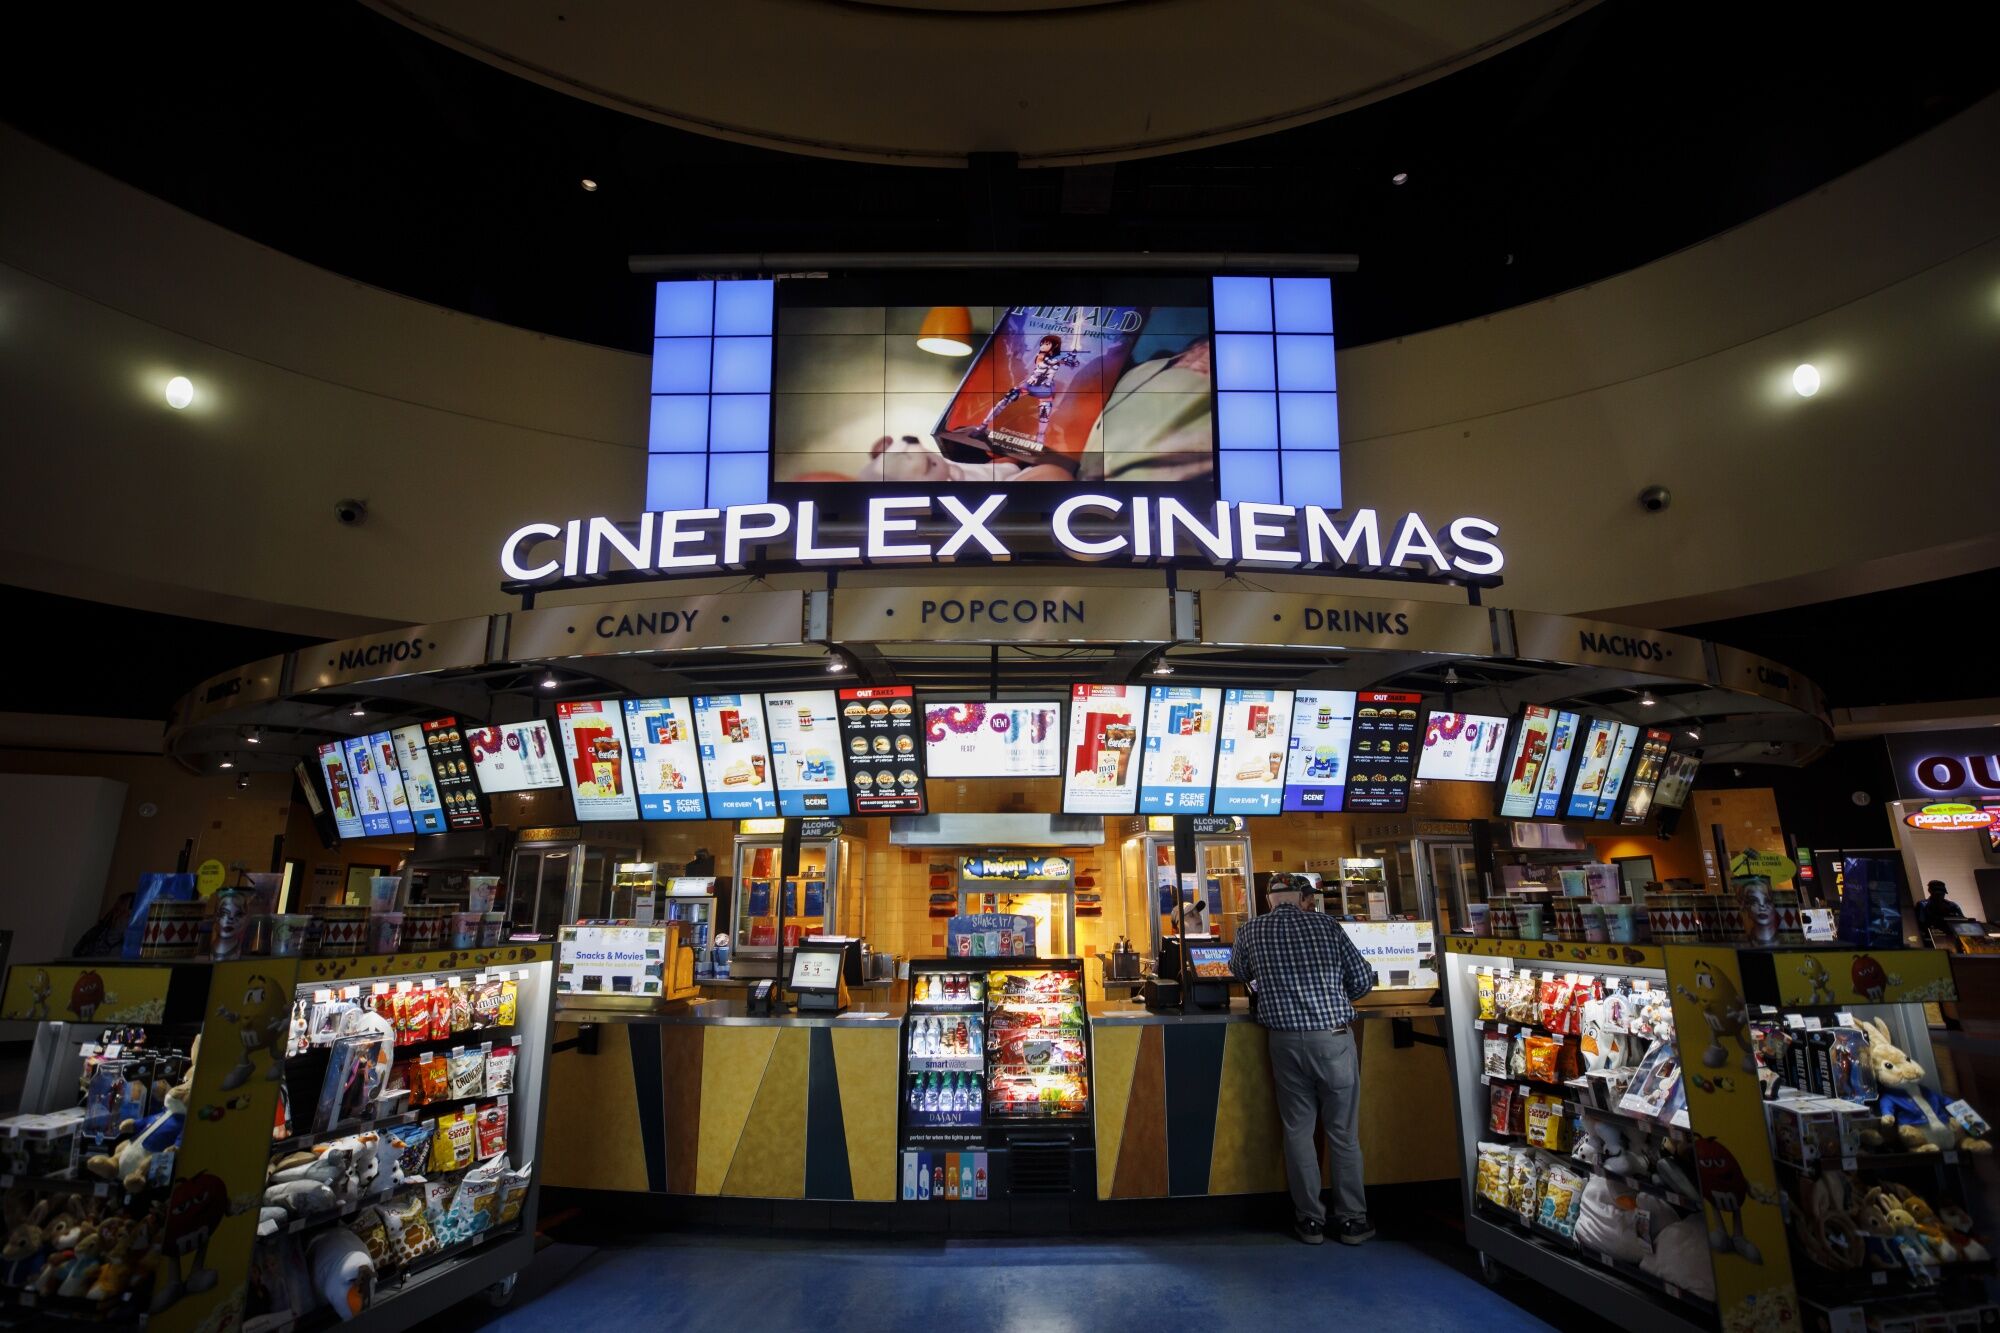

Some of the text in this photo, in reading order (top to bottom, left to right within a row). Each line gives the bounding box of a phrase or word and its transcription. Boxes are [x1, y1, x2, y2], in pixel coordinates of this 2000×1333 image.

[1029, 320, 1075, 334] WARRIOR
[988, 431, 1044, 452] SUPERNOVA
[500, 494, 1505, 581] CINEPLEX CINEMAS
[921, 599, 1085, 626] POPCORN
[595, 609, 699, 639] CANDY
[1304, 607, 1409, 637] DRINKS
[1579, 630, 1664, 662] NACHOS
[338, 638, 423, 671] NACHOS
[1078, 686, 1084, 694] 1
[1156, 688, 1162, 696] 2
[1230, 690, 1236, 700] 3
[628, 701, 634, 710] 2
[698, 698, 704, 706] 3
[560, 704, 566, 713] 1
[992, 718, 1007, 728] NEW!
[1150, 738, 1156, 747] 4
[1224, 740, 1230, 749] 5
[635, 748, 641, 757] 4
[704, 746, 710, 754] 5
[1164, 793, 1174, 806] 5
[663, 800, 672, 812] 5
[1914, 814, 1952, 827] pizza
[1952, 812, 1991, 826] pizza
[983, 860, 1027, 876] Popcorn
[972, 916, 1012, 928] SHAKE IT!
[1385, 946, 1415, 954] Movies
[576, 951, 605, 960] Snacks
[614, 952, 644, 960] Movies
[926, 1060, 967, 1068] smartwater
[930, 1112, 962, 1123] DASANI
